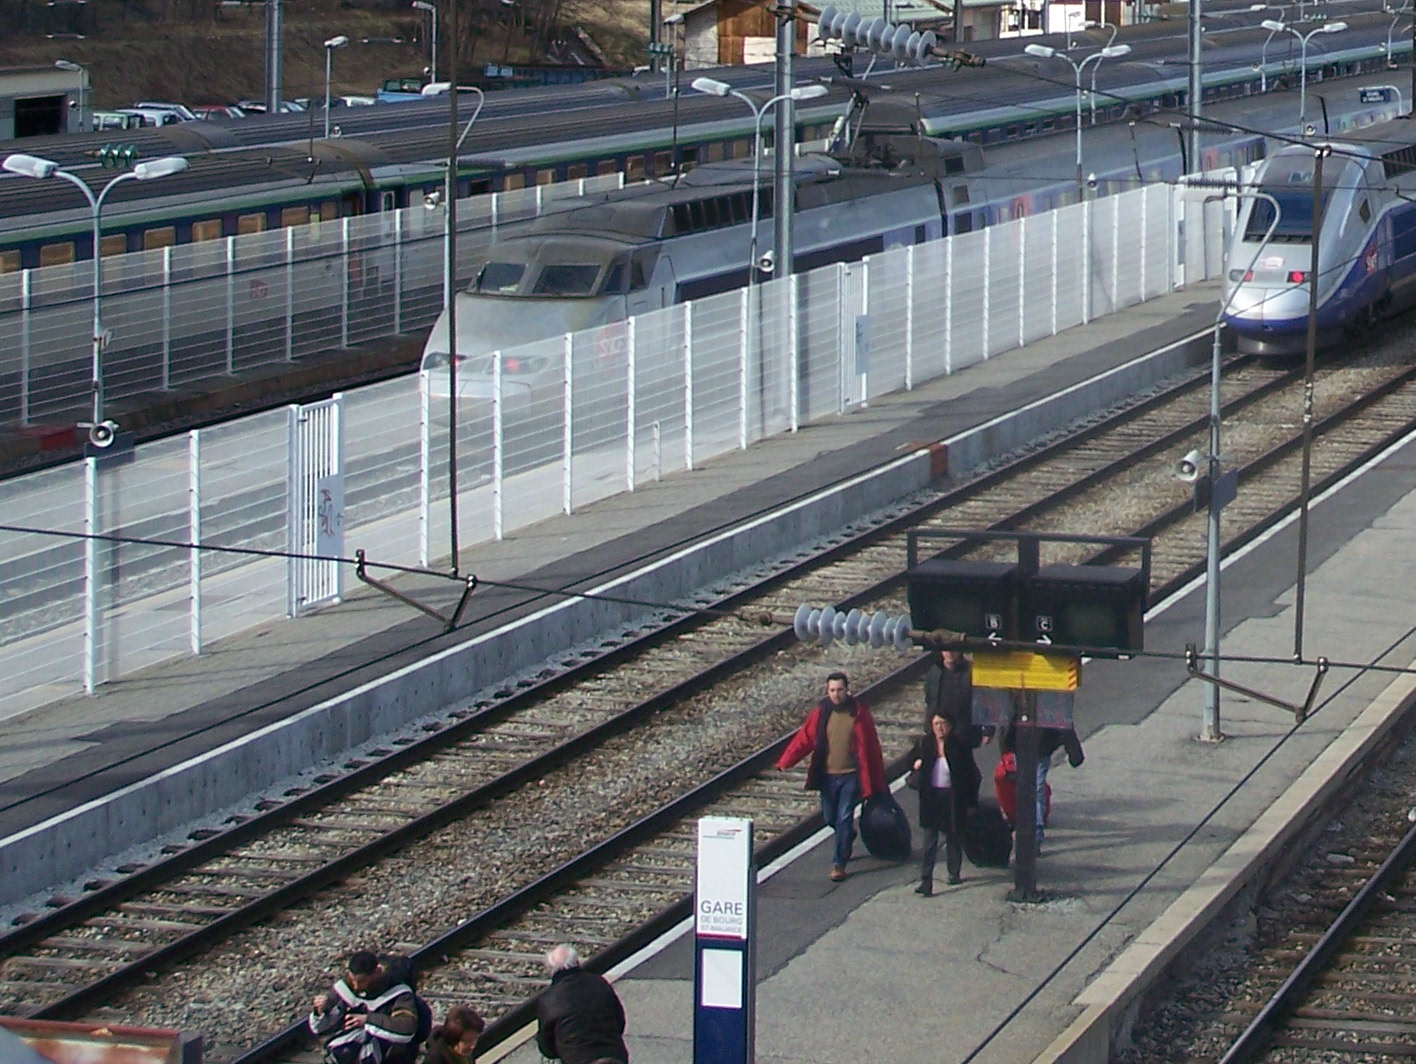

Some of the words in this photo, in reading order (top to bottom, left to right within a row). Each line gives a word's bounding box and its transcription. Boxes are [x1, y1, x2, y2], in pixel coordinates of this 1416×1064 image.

[700, 900, 743, 916] GARE
[701, 915, 711, 923] DE
[713, 916, 742, 925] BOURG
